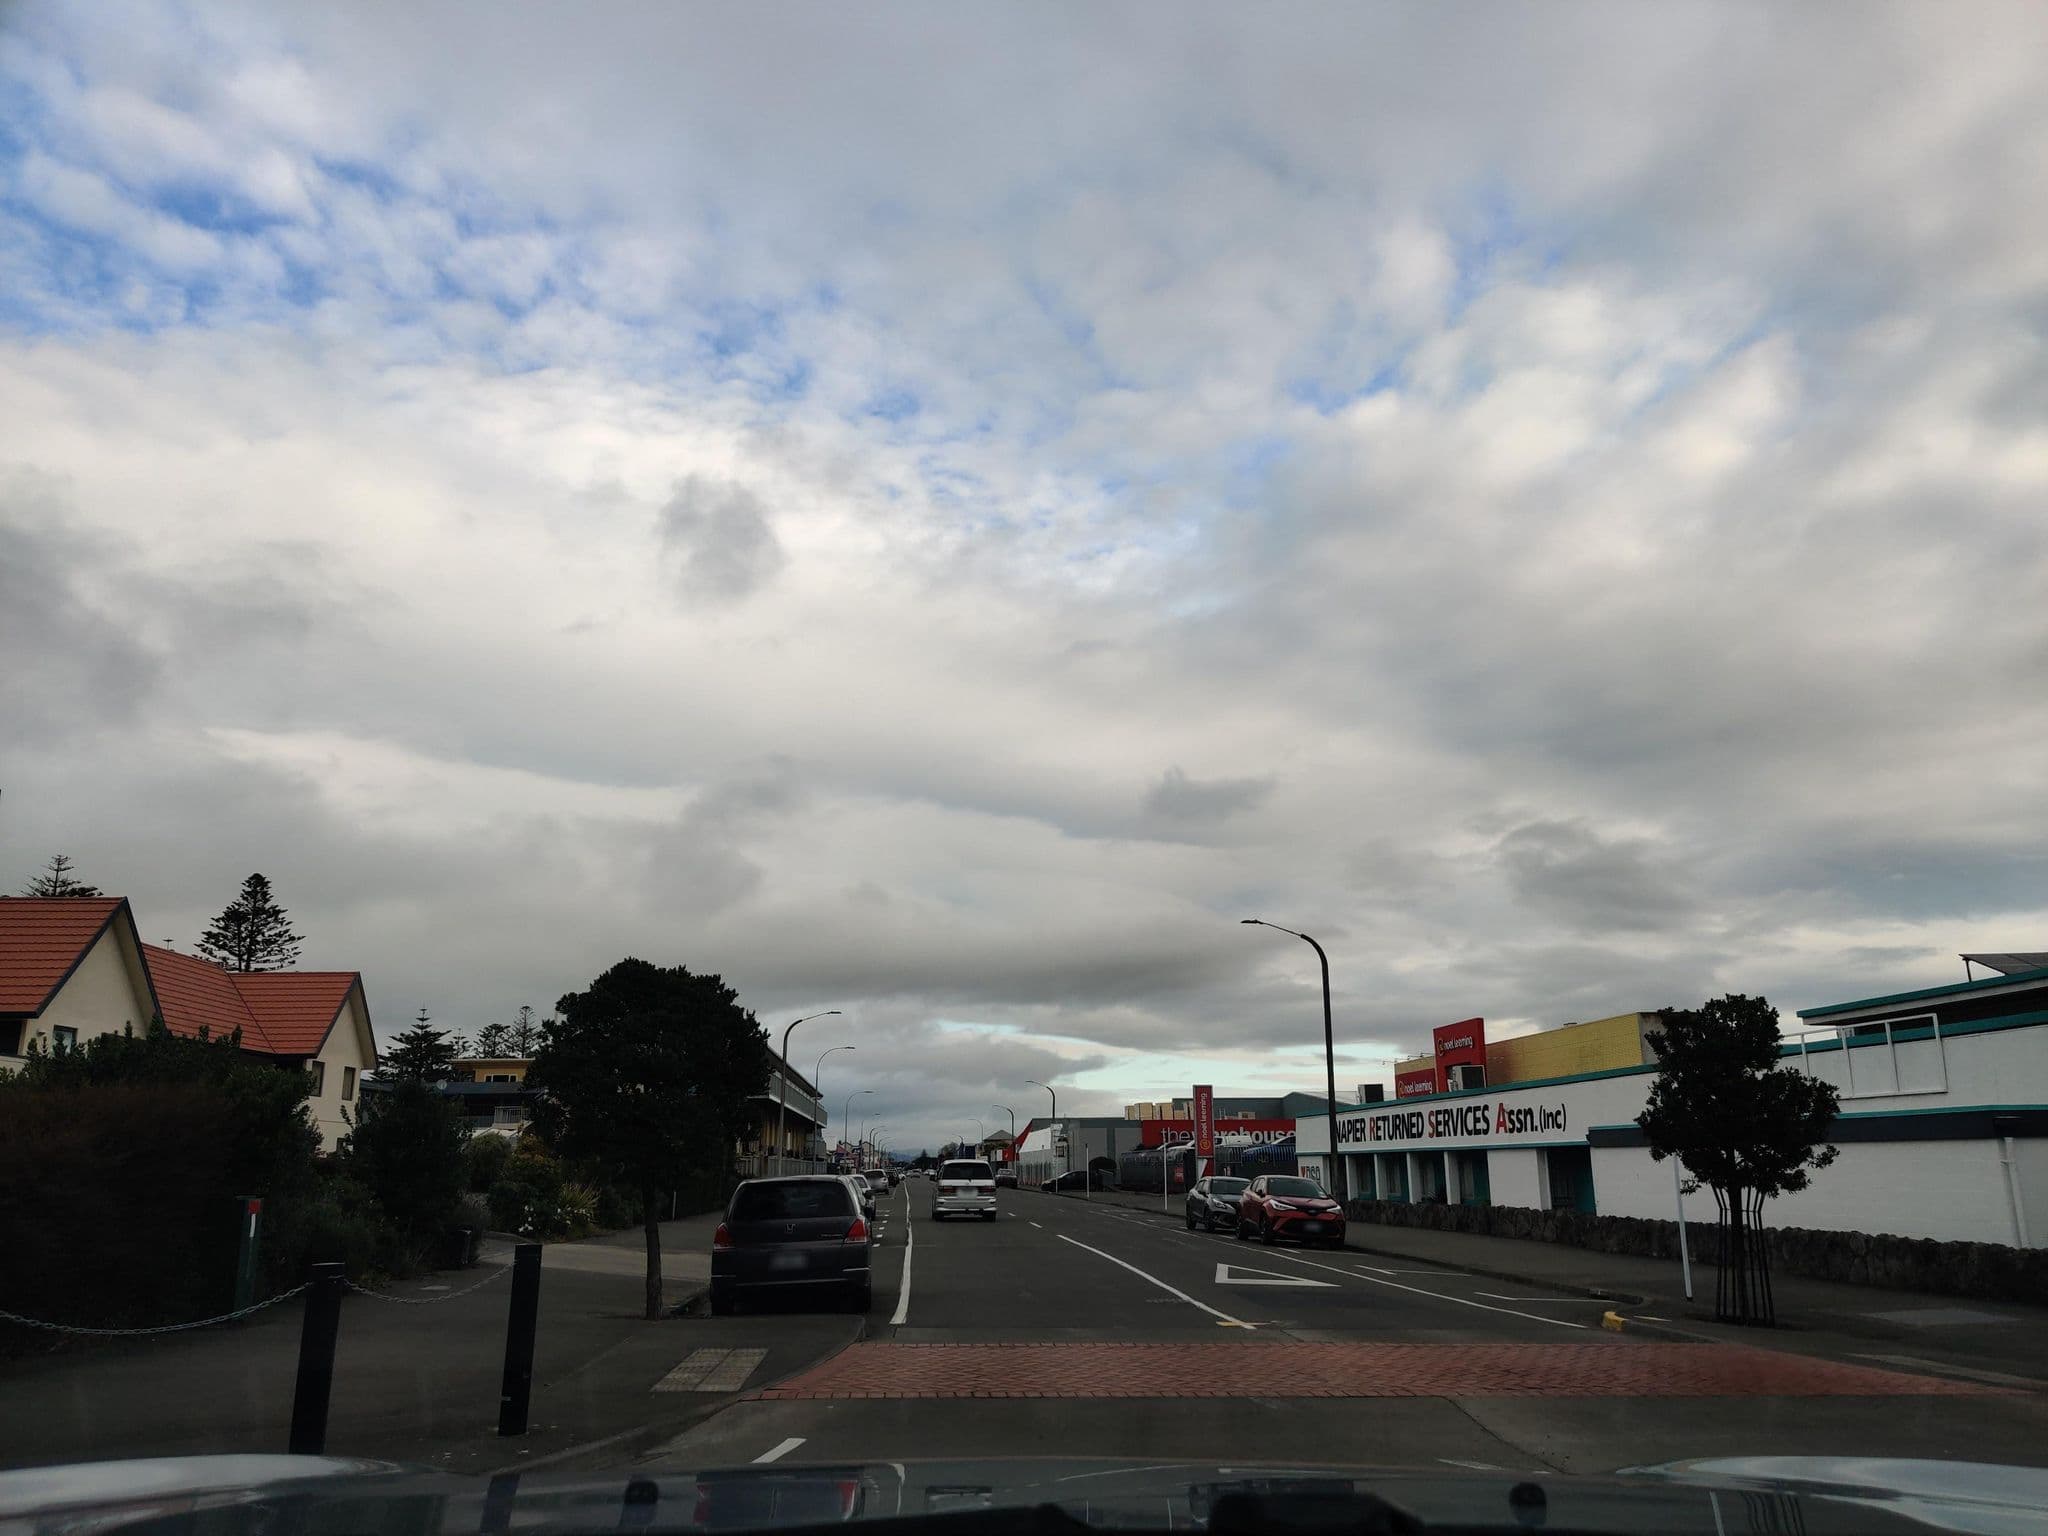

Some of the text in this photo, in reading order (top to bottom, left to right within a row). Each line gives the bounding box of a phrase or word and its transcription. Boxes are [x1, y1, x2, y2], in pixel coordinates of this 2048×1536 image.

[1336, 1117, 1366, 1143] NAPIER
[1370, 1111, 1424, 1142] RETURNED
[1428, 1104, 1489, 1138] SERVICES
[1496, 1102, 1538, 1133] Assn.
